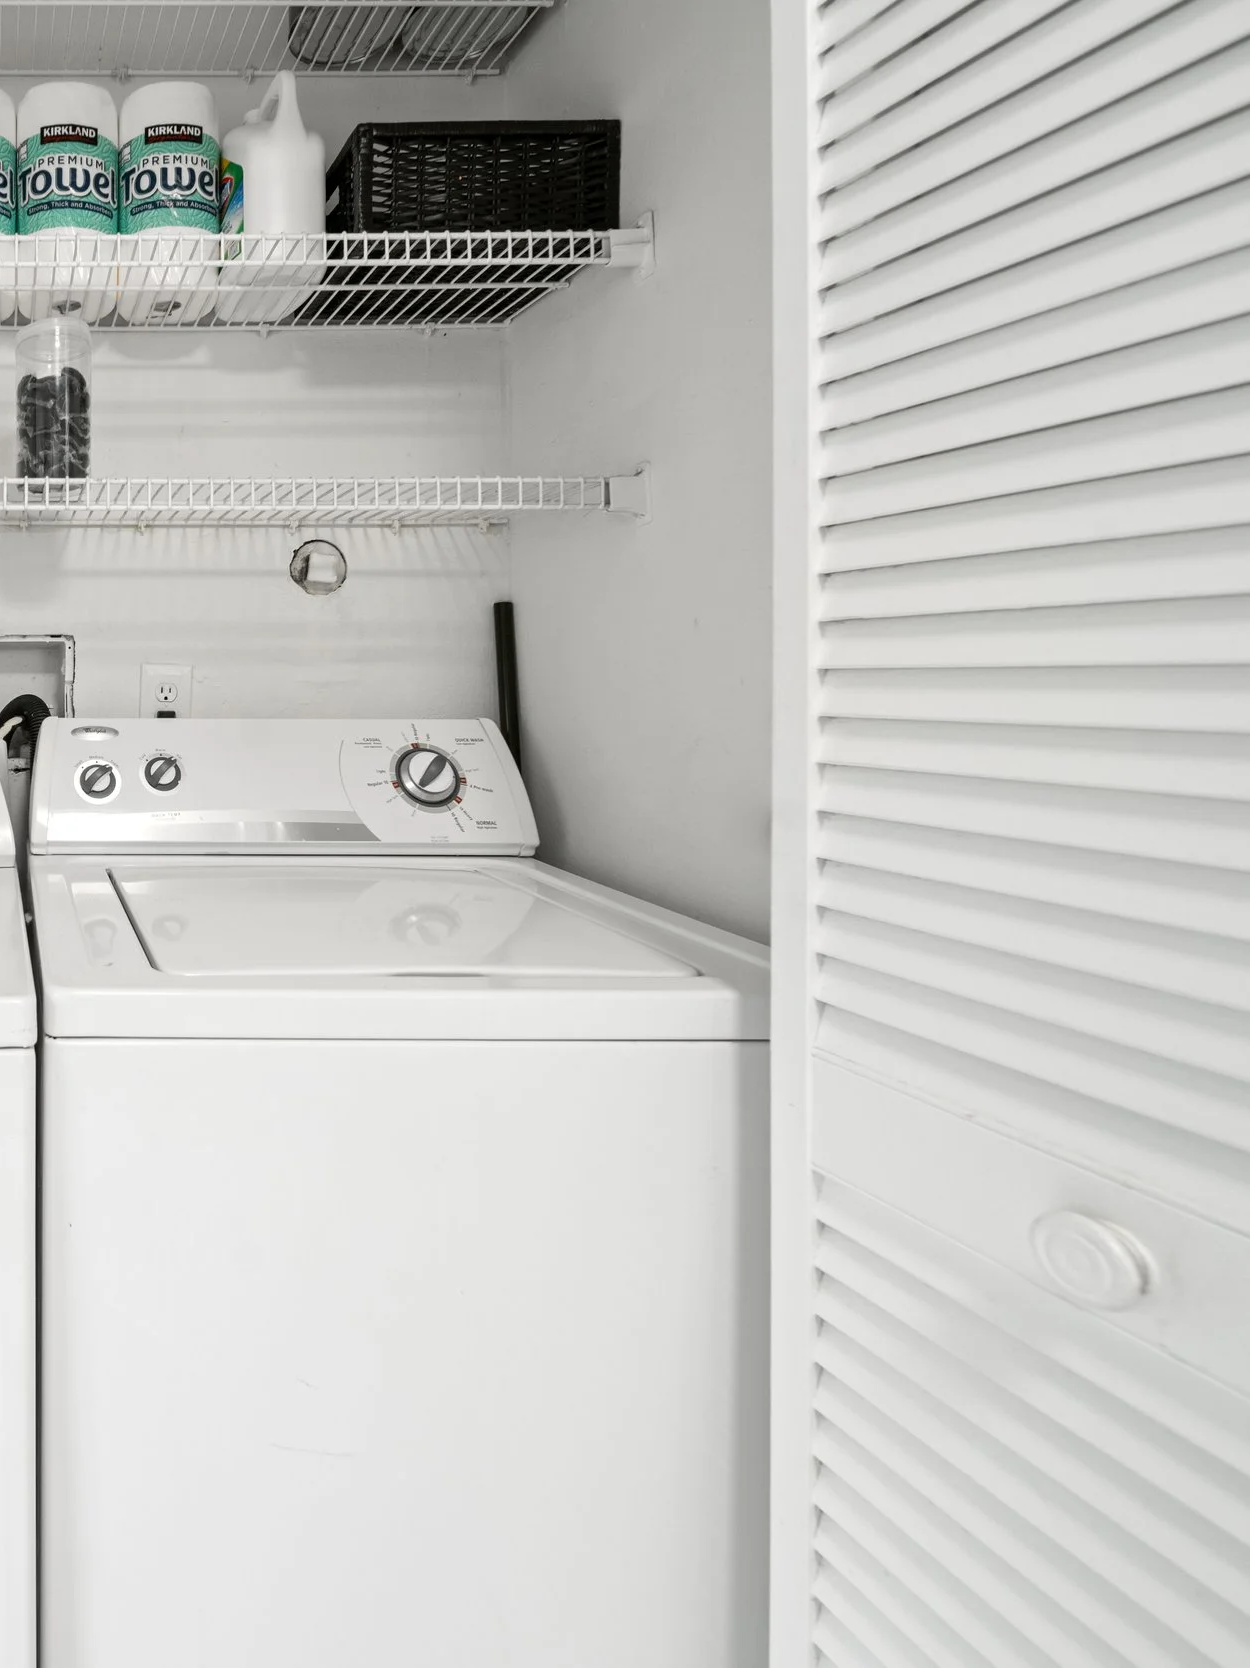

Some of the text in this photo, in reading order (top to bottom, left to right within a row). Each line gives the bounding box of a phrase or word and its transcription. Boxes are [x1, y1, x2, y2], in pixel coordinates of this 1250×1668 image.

[43, 125, 96, 138] KIRKLAND
[147, 125, 201, 137] KIRKLAND
[38, 155, 103, 170] PREMIUM
[142, 155, 208, 169] PREMIUM
[18, 166, 116, 207] Towel
[121, 166, 219, 205] Towel
